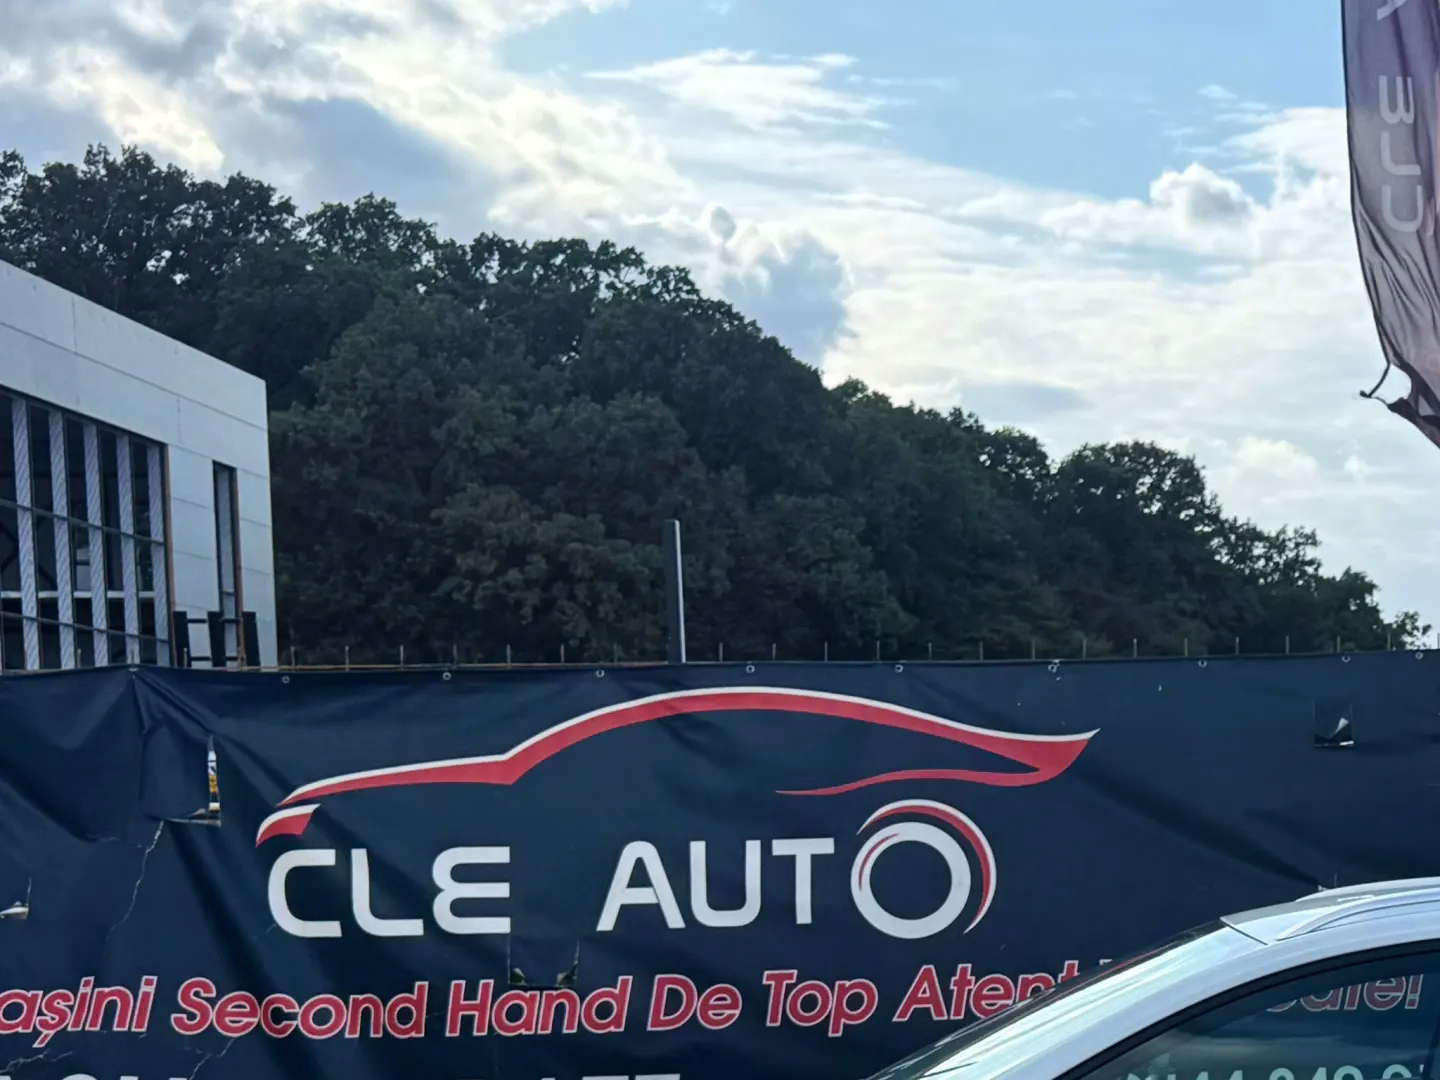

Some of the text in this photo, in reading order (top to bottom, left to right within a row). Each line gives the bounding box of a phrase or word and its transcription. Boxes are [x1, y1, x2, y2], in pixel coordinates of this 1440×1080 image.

[267, 821, 971, 939] CLE AUTO
[171, 977, 429, 1039] Second
[445, 976, 635, 1037] Hand
[647, 973, 742, 1031] De
[762, 969, 878, 1037] Top
